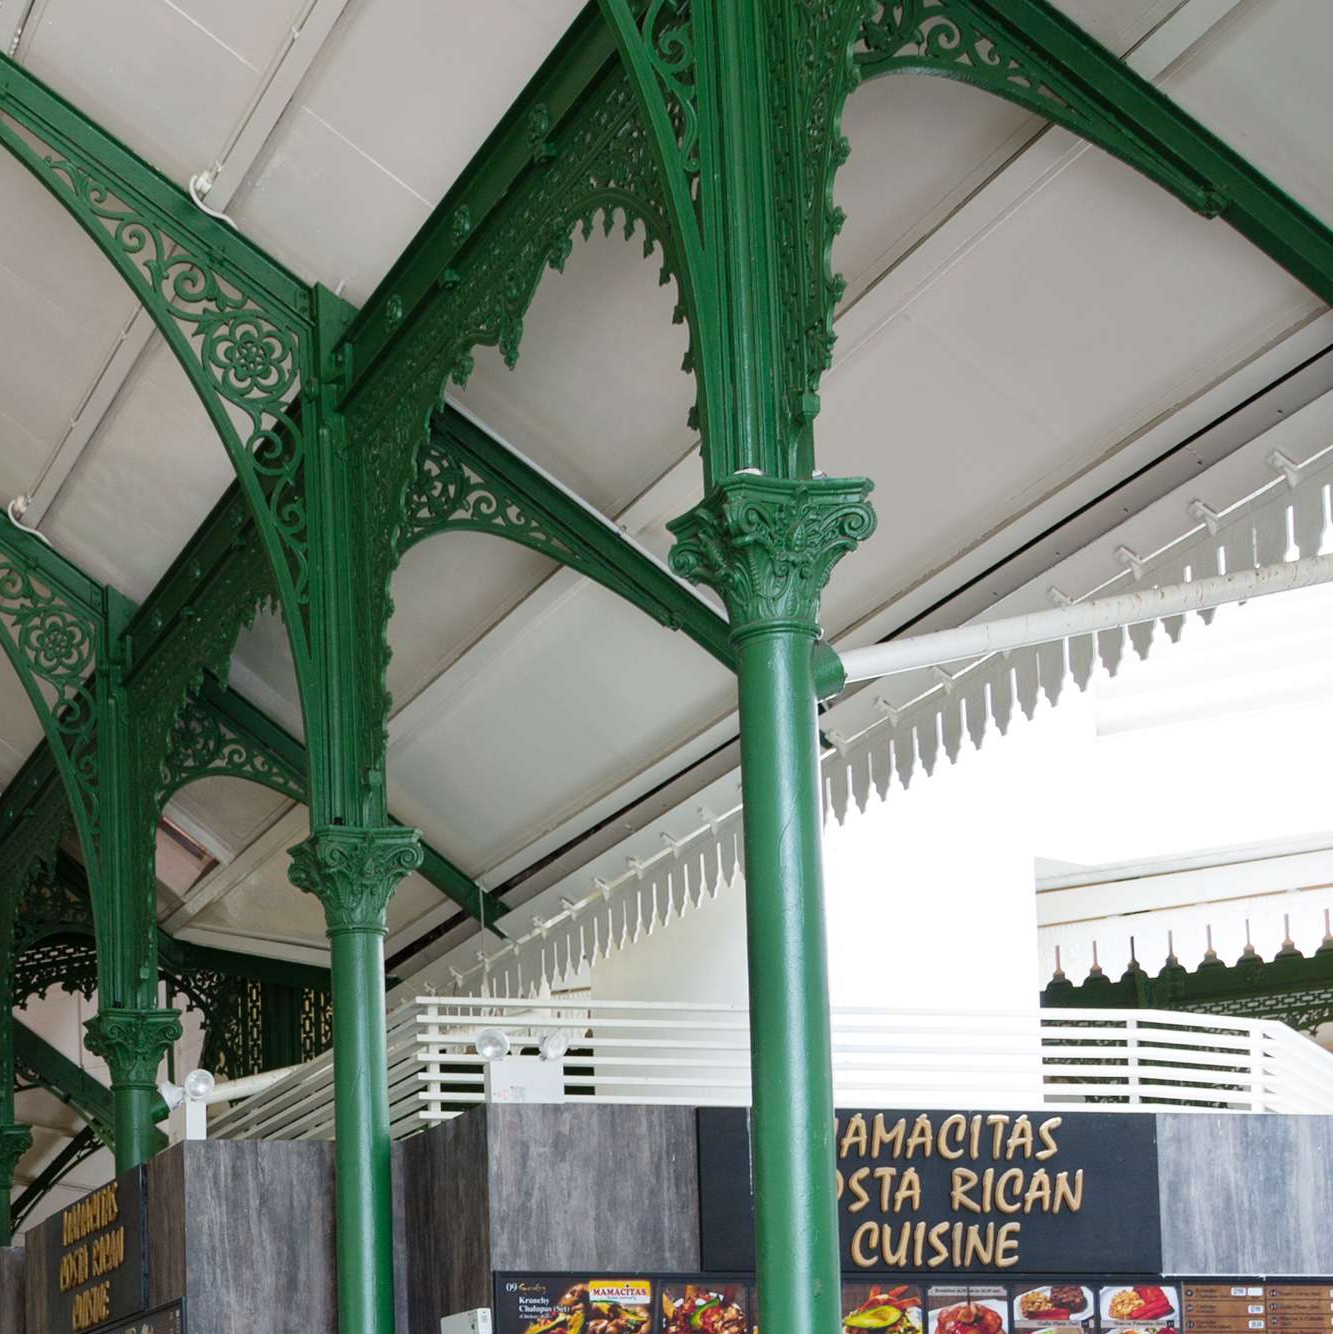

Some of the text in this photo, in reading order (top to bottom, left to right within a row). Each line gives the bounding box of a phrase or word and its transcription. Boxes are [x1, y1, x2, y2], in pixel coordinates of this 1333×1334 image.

[835, 1112, 1062, 1161] AMACITAS
[950, 1167, 1084, 1215] RICAN
[851, 1220, 1022, 1269] CUISINE
[593, 1287, 647, 1297] MAMACITAS
